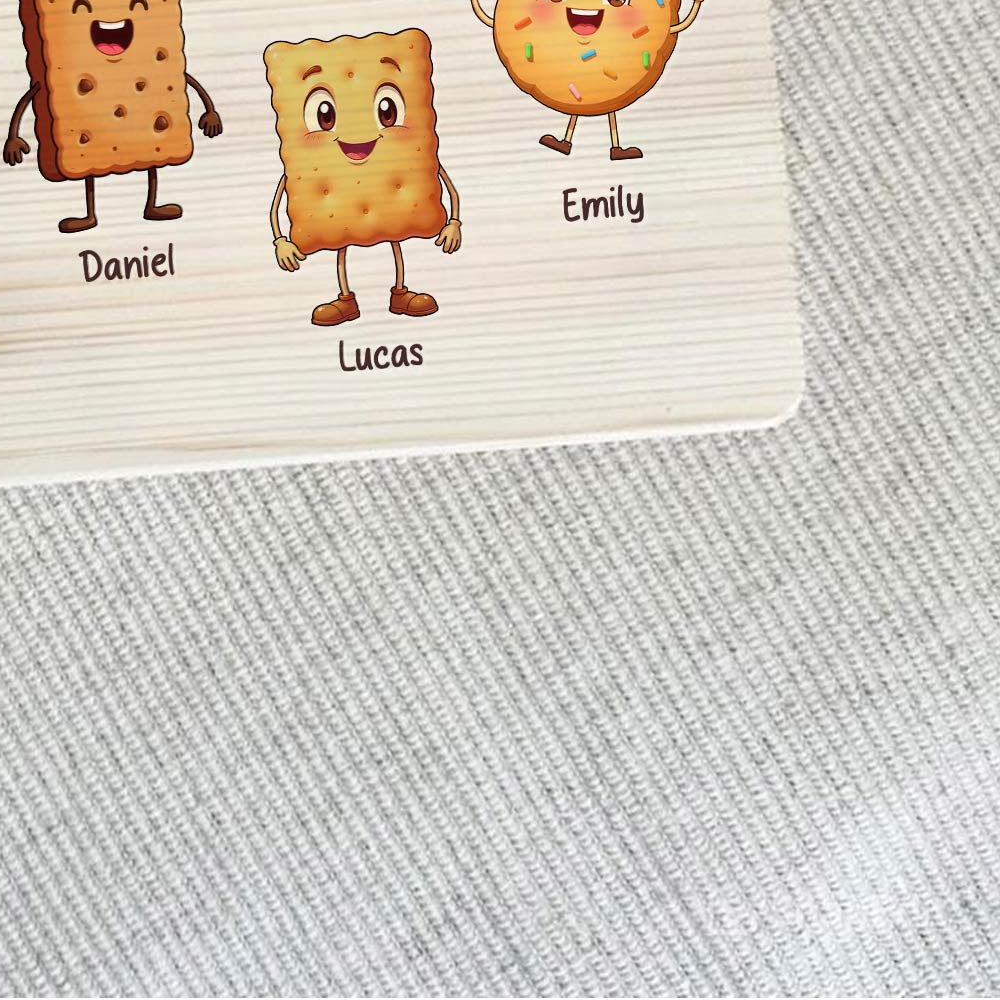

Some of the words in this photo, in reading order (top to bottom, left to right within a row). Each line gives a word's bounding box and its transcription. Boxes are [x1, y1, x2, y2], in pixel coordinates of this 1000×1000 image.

[562, 184, 645, 224] Emily
[78, 242, 175, 283] Daniel
[339, 340, 424, 372] Lucas
